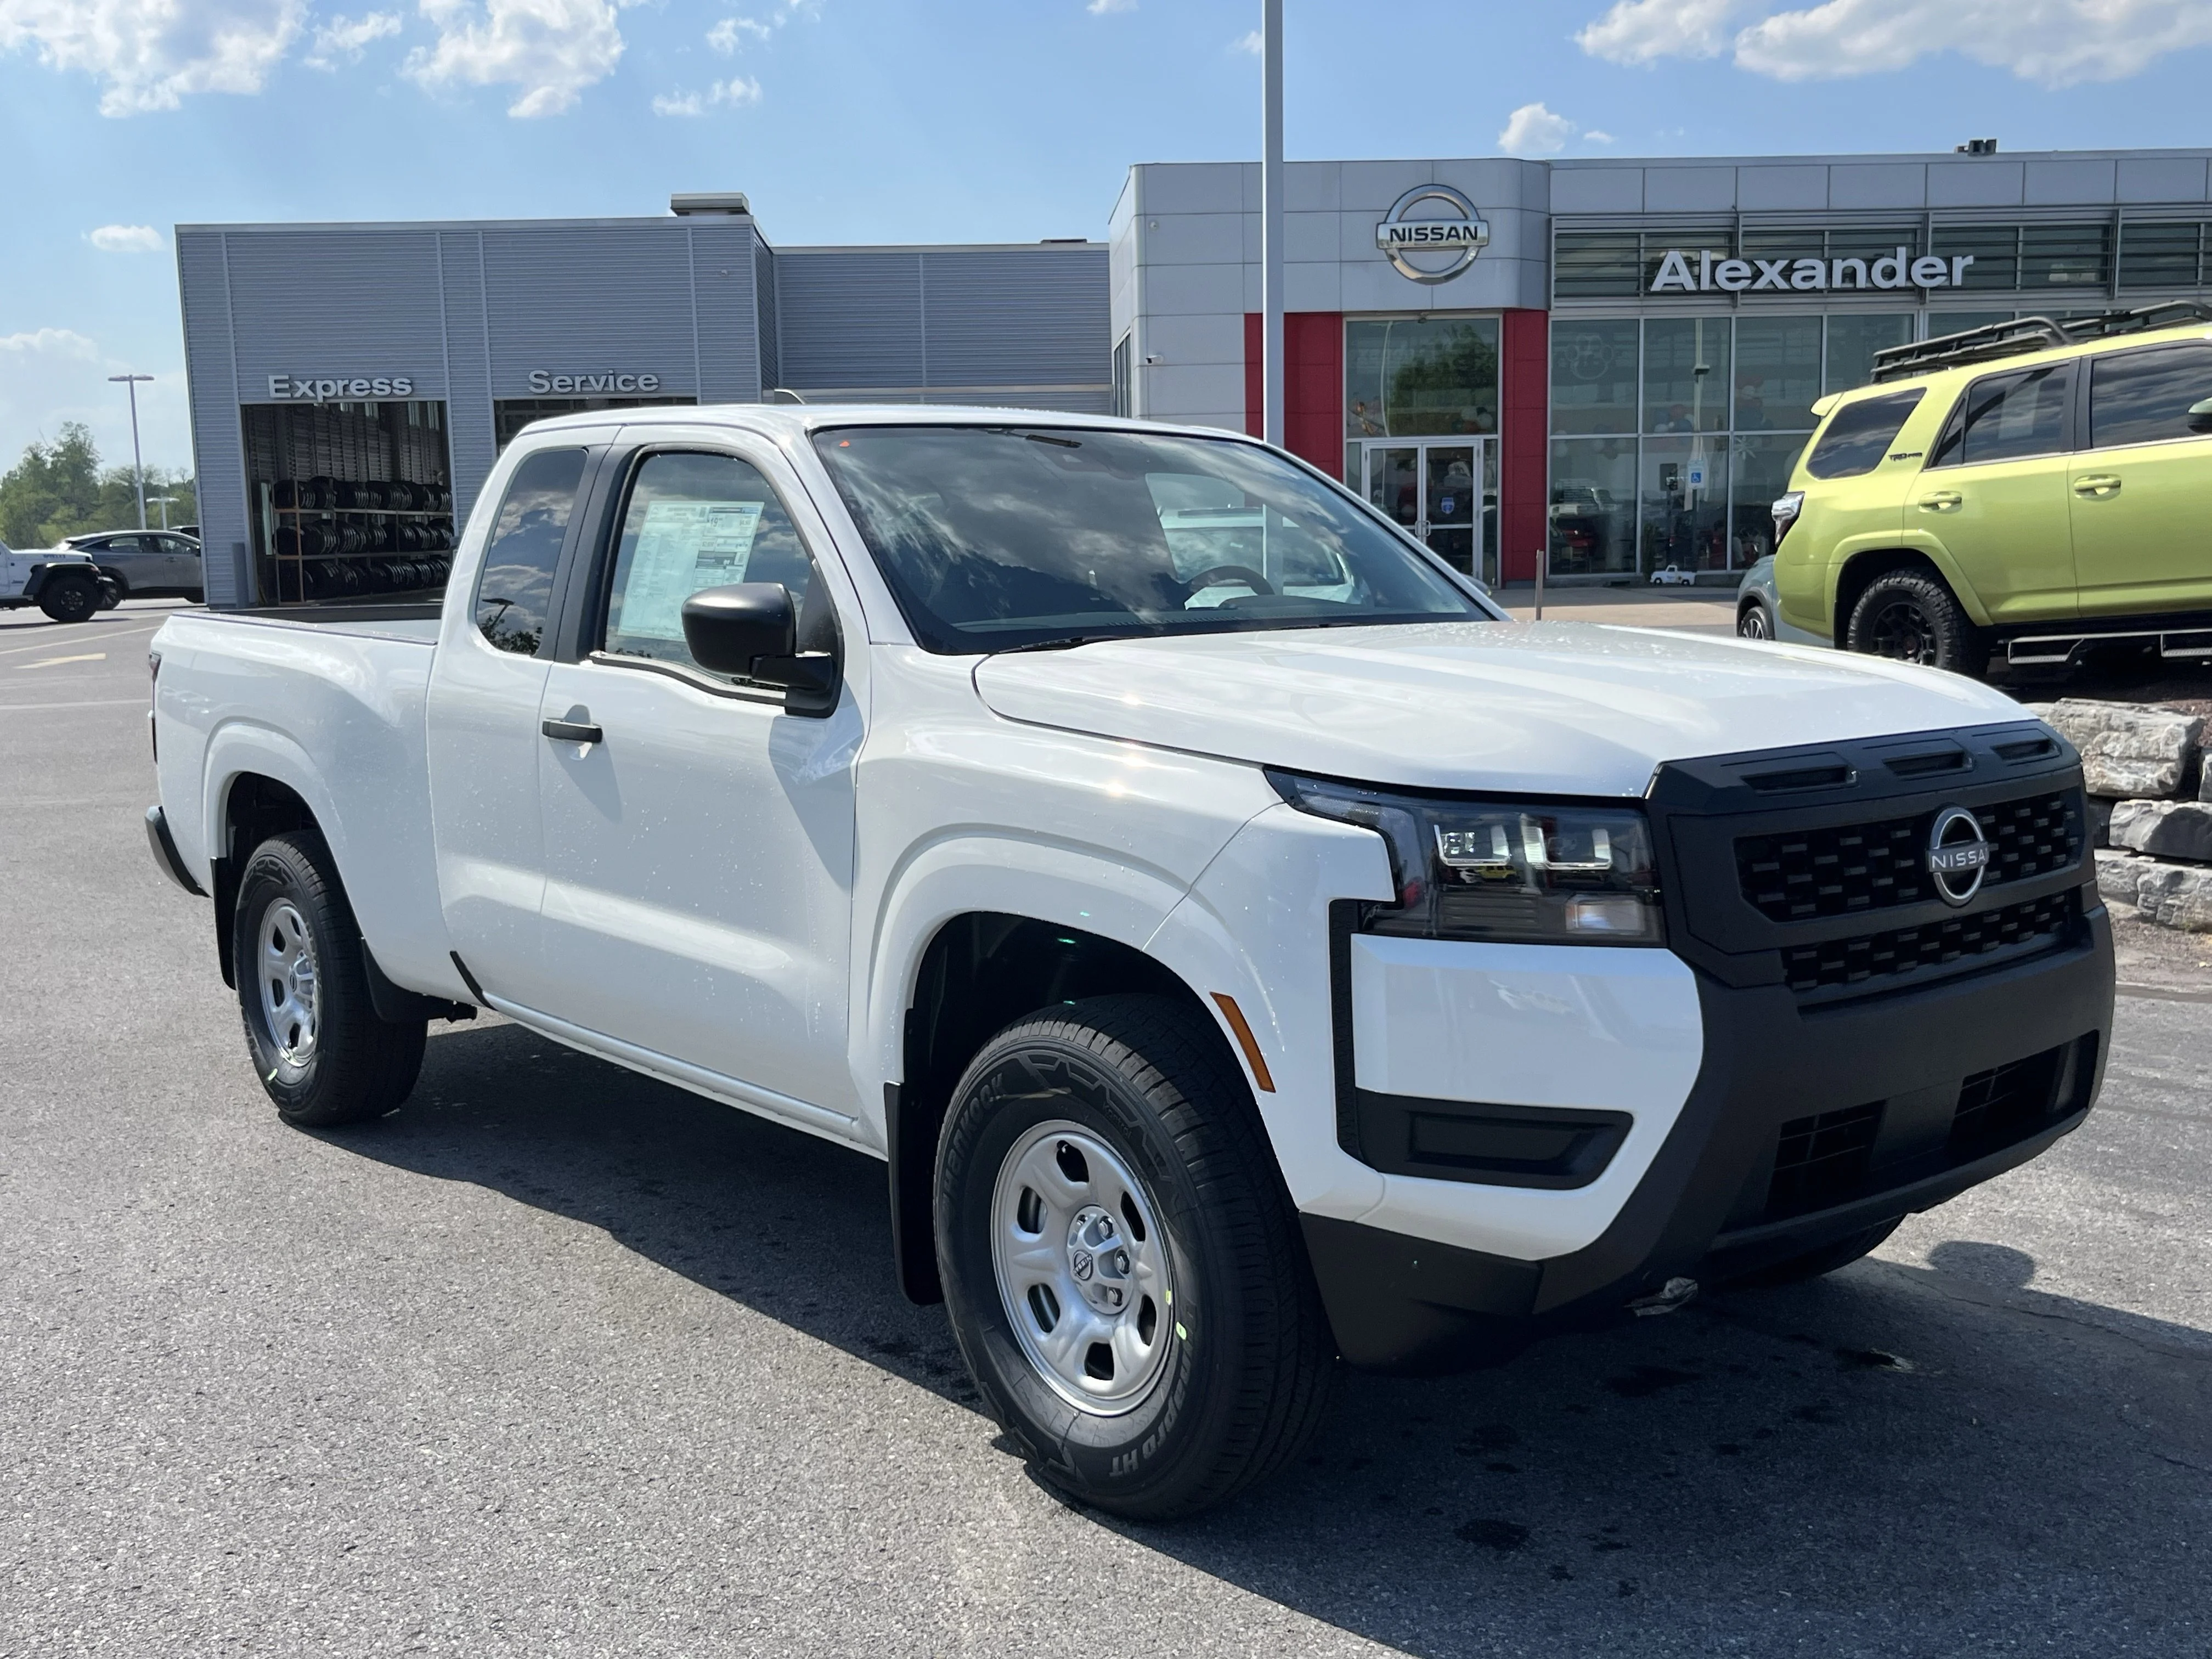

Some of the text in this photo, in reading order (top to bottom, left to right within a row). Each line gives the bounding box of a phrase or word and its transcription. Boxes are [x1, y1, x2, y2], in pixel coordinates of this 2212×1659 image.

[1390, 225, 1477, 242] NISSAN
[1650, 246, 1974, 291] Alexander
[268, 375, 412, 403] Express
[528, 370, 659, 394] Service
[1932, 847, 1988, 869] NISSA
[1109, 1449, 1139, 1477] HT
